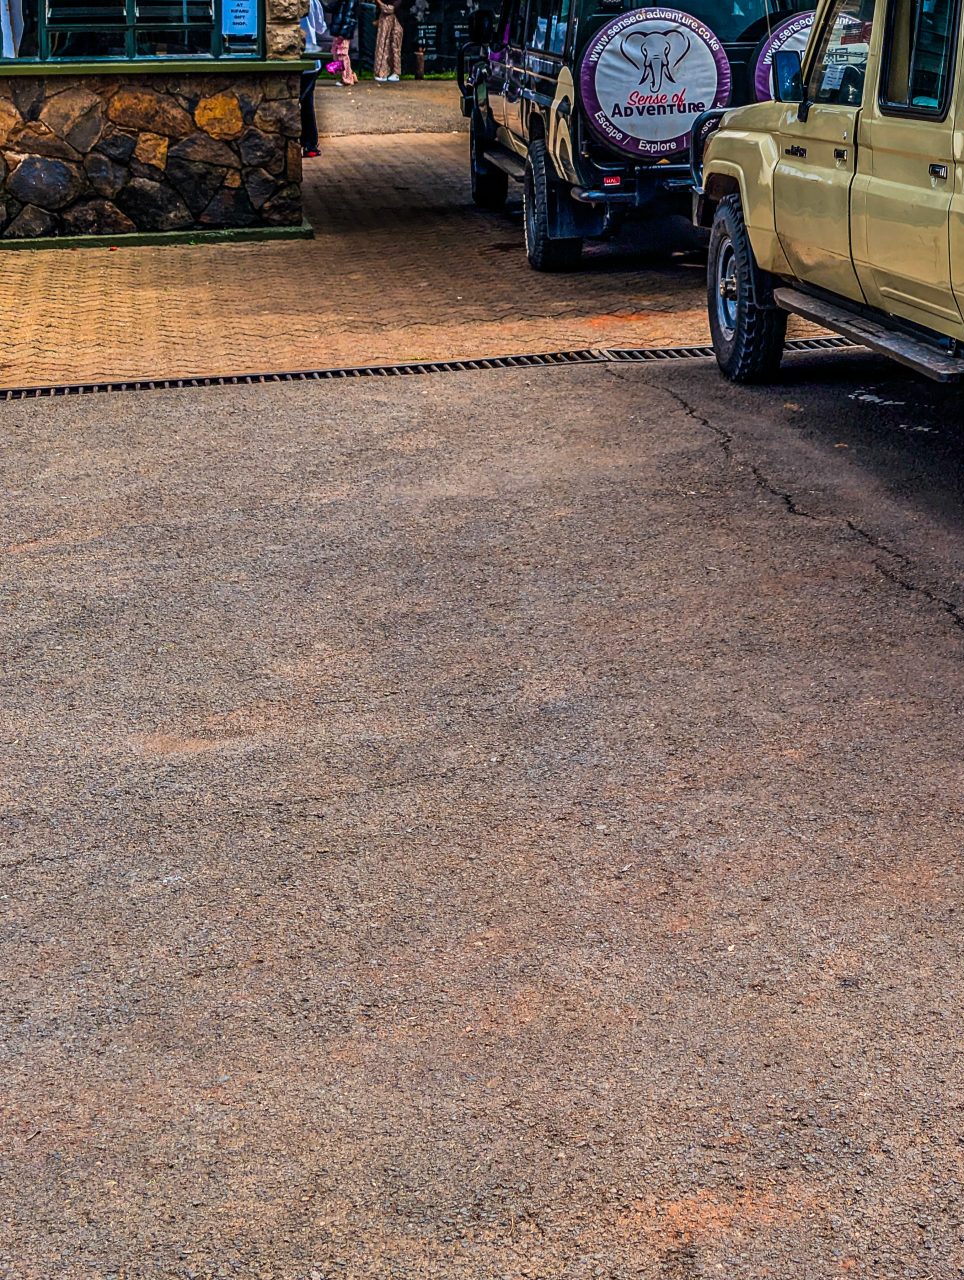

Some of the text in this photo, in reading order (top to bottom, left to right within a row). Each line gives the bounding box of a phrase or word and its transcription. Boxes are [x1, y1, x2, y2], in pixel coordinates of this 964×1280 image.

[589, 9, 720, 63] www.senseofadventure.co.ke
[626, 87, 687, 108] Sense of
[594, 110, 623, 141] Escape
[638, 140, 677, 154] Explore
